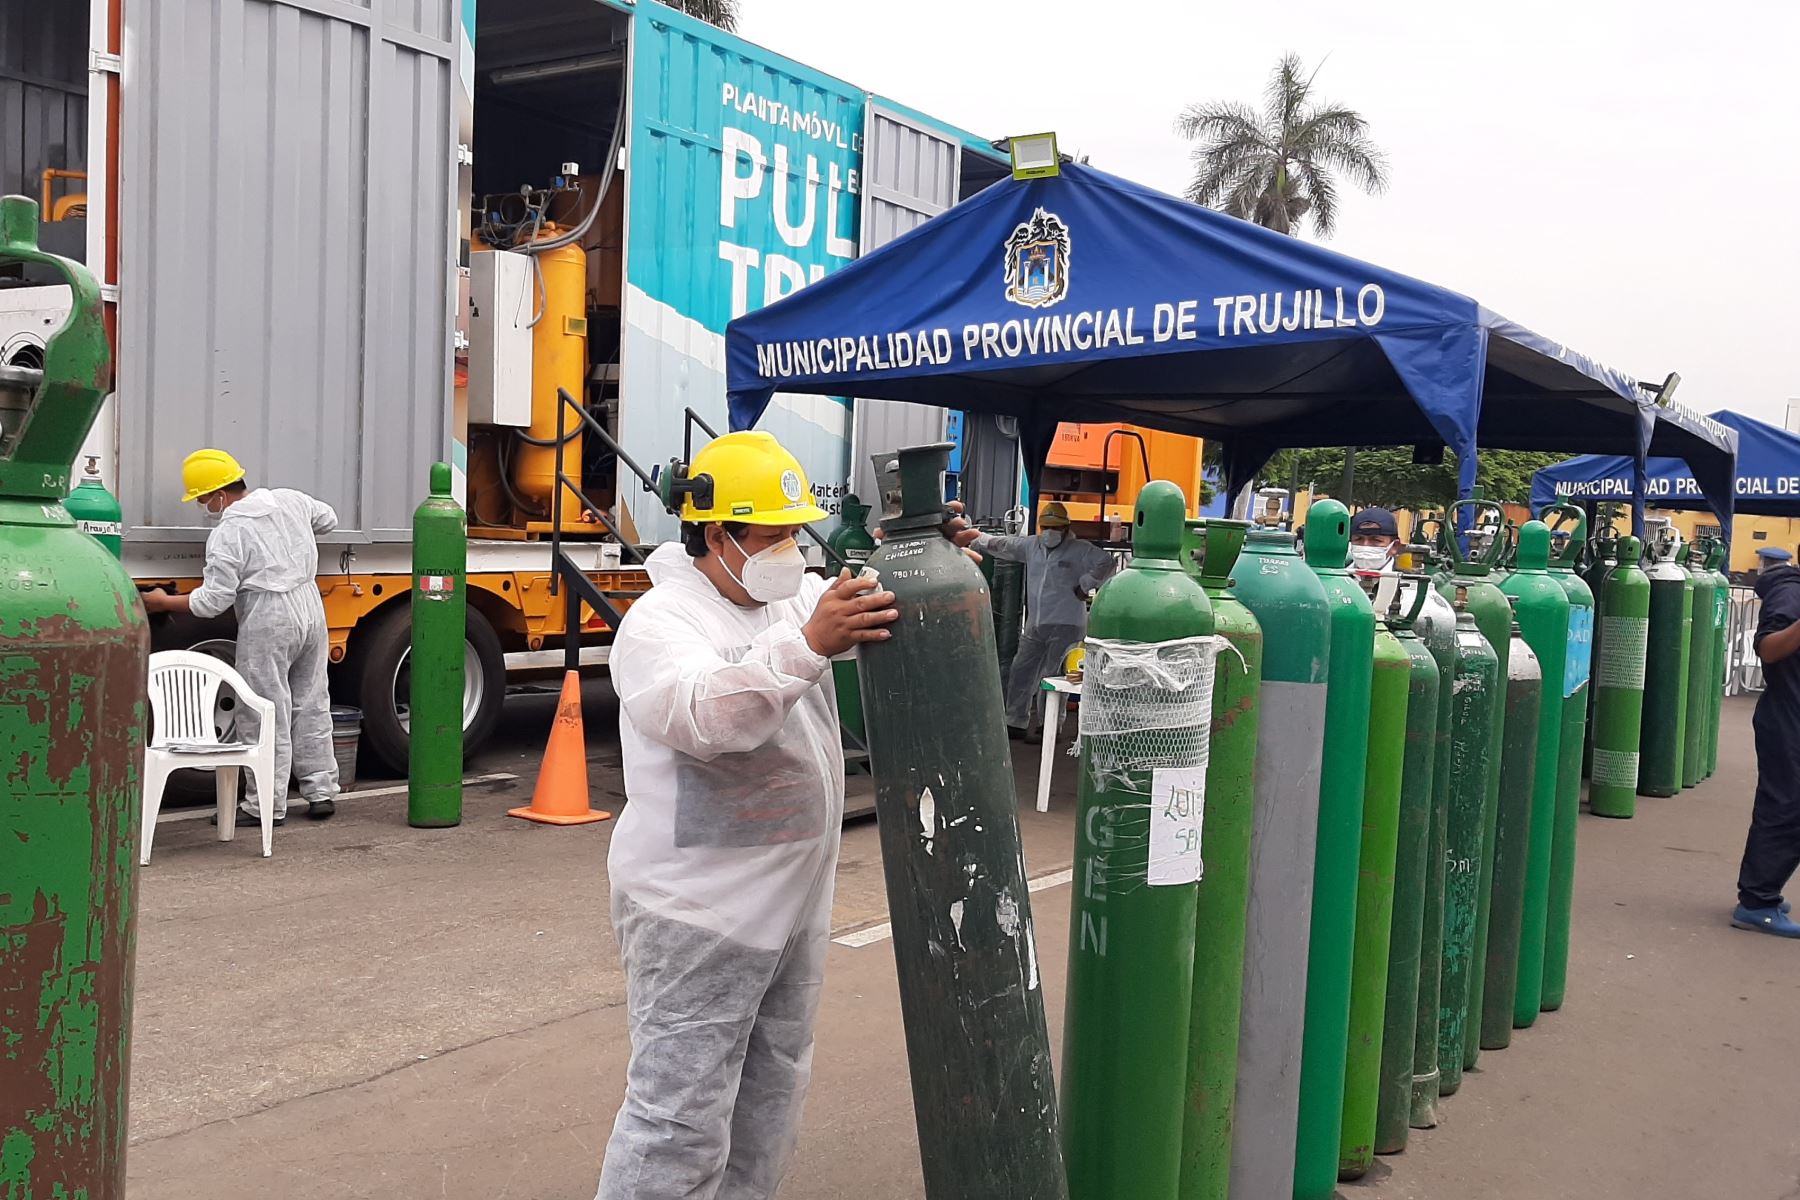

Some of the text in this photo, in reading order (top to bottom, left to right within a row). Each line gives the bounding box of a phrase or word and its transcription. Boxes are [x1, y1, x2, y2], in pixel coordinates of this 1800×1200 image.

[756, 283, 1385, 378] MUNICIPALIDAD PROVINCIAL DE TRUJILLO
[1554, 477, 1670, 496] MUNICIPALAD
[1777, 477, 1800, 495] DE
